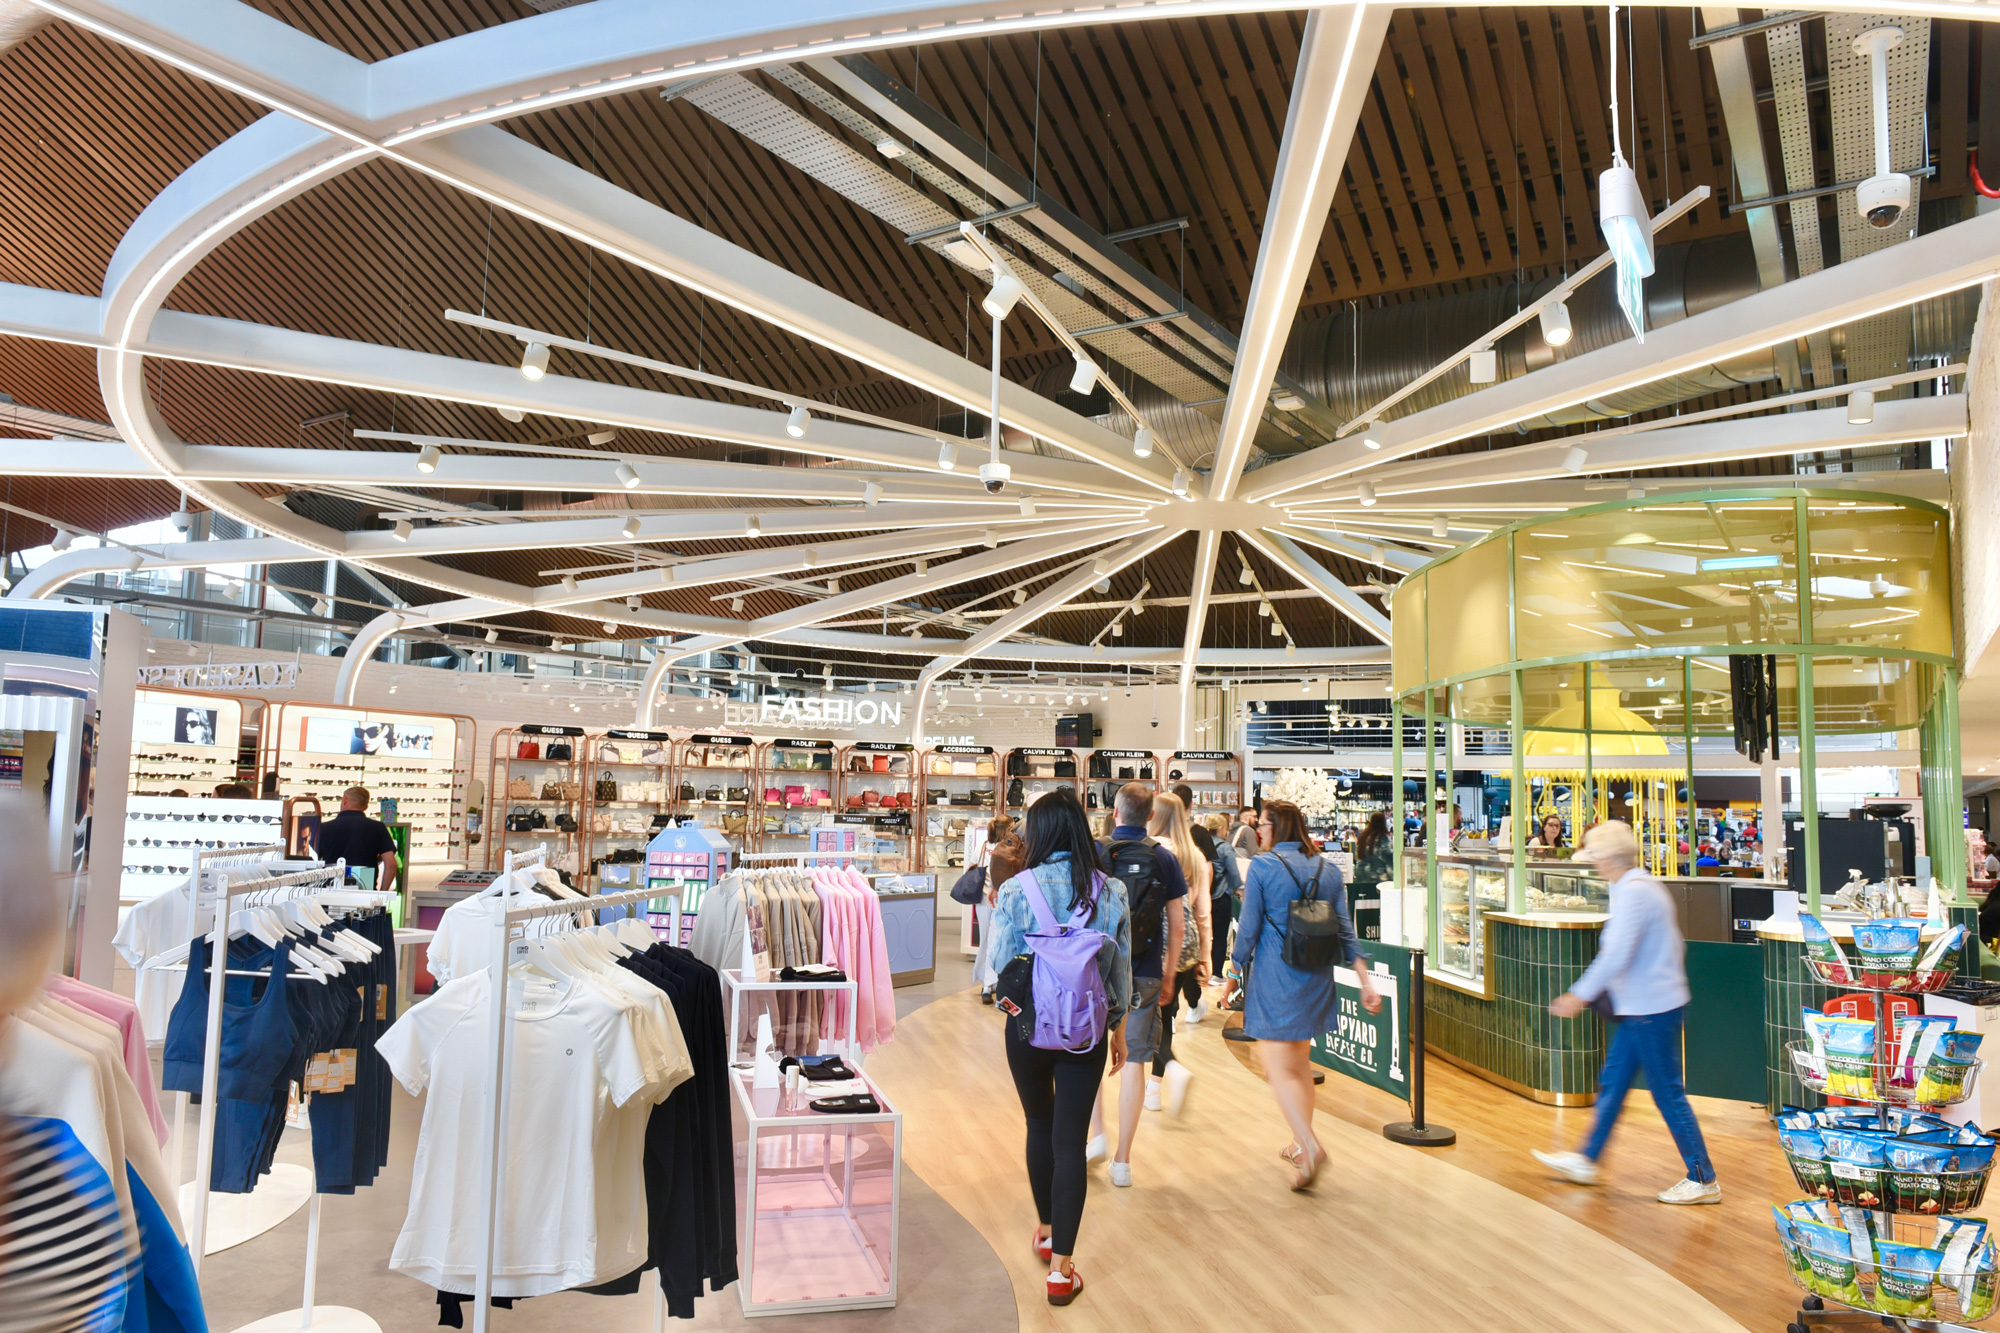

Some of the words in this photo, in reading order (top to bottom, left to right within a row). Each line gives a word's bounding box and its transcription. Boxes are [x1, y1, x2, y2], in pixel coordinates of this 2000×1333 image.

[761, 695, 901, 725] FASHION
[541, 726, 564, 735] GUESS
[627, 731, 649, 740] GUESS
[710, 736, 733, 745] GUESS
[791, 740, 817, 748] RADLEY
[870, 743, 896, 751] RADLEY
[942, 746, 985, 754] ACCESSORIES
[1102, 750, 1125, 758] CALVIN
[1126, 751, 1145, 759] KLEIN
[1182, 751, 1205, 759] CALVIN
[1206, 752, 1225, 760] KLEIN
[1340, 997, 1358, 1017] THE
[1360, 1047, 1378, 1068] CO.
[1881, 1275, 1904, 1287] HAND
[1882, 1282, 1909, 1294] POTATO
